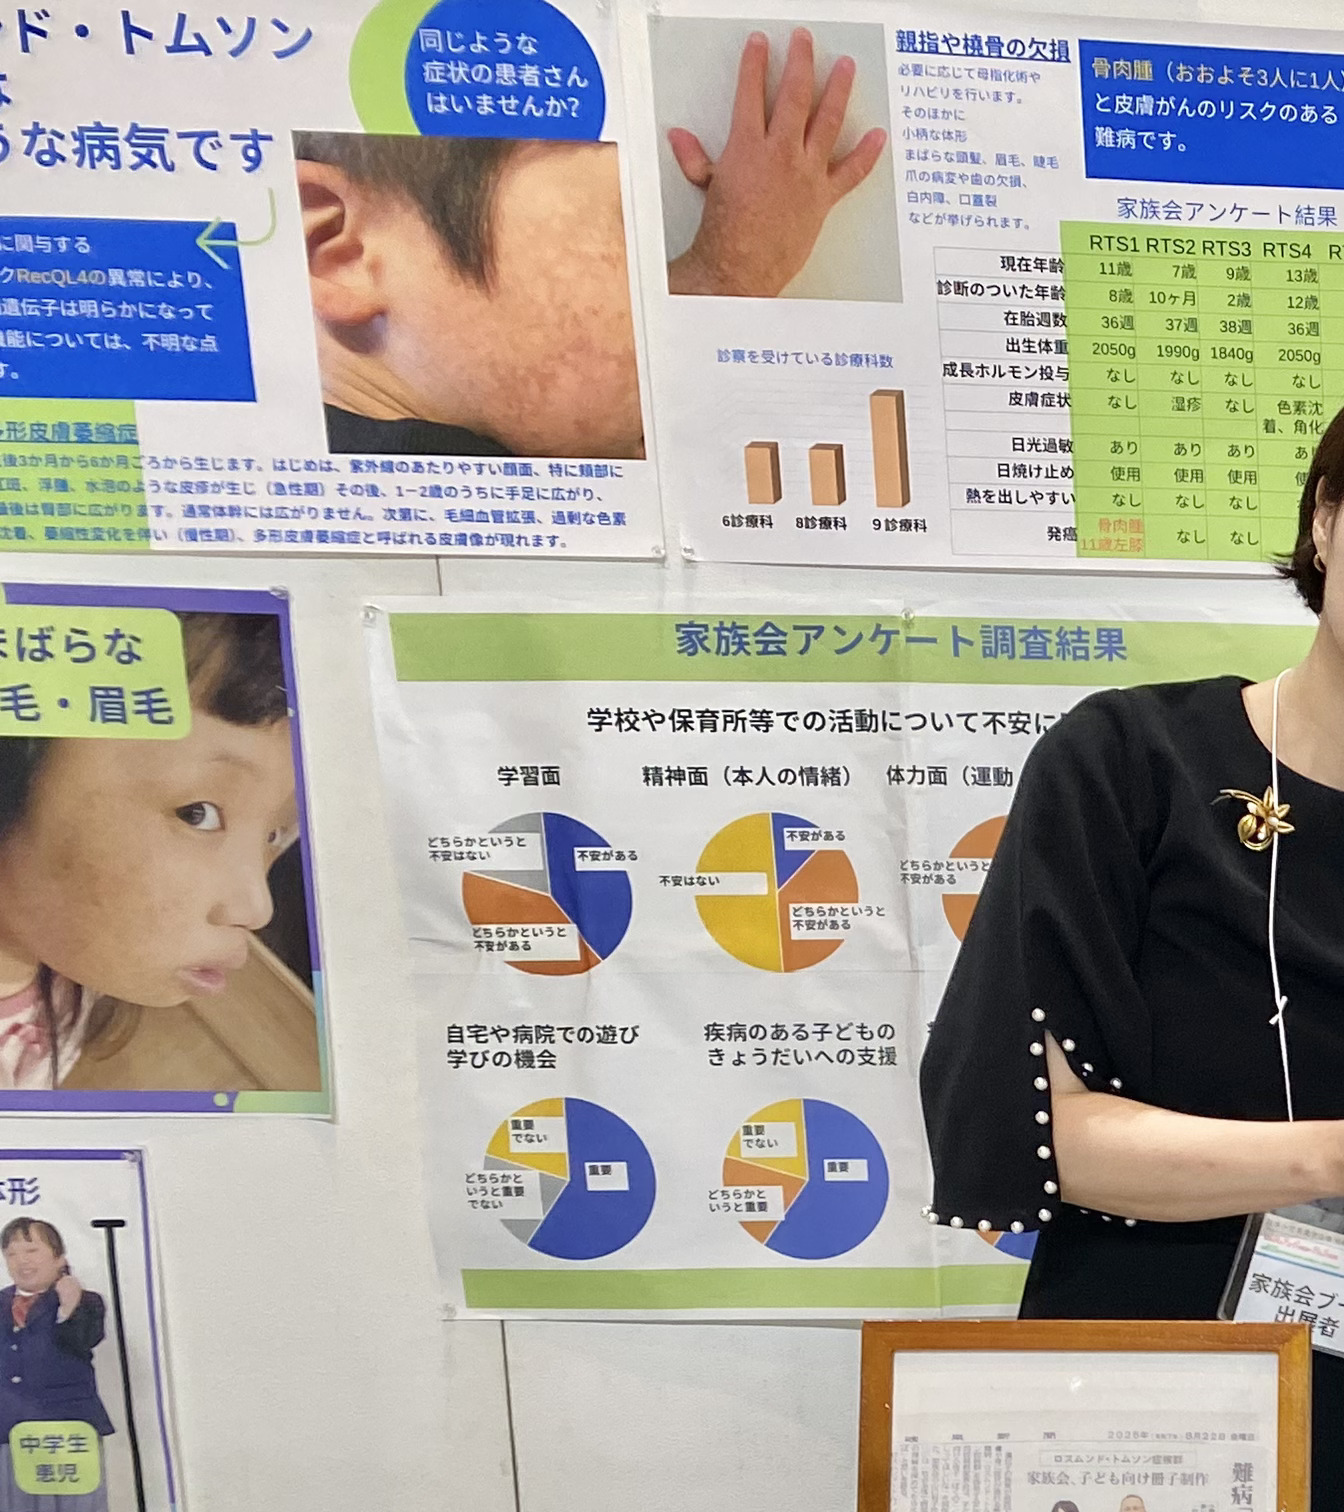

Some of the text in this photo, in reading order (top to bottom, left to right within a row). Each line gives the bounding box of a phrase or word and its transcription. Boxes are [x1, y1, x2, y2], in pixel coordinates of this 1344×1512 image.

[0, 9, 314, 58] ド・トムソン
[418, 28, 538, 55] 同じような
[422, 63, 589, 89] 症状の患者さん
[900, 85, 1023, 104] リハビリを行います。
[902, 106, 966, 121] そのほかに
[1094, 92, 1339, 126] と皮膚がんのリスクのある
[903, 128, 968, 143] 小柄な体形
[1094, 126, 1190, 154] 難病です。
[909, 212, 1030, 230] などが挙げられます。
[1116, 197, 1339, 228] 家族会アンケート結果
[1089, 234, 1140, 253] RTS1
[1146, 238, 1197, 256] RTS2
[1202, 240, 1252, 258] RTS3
[1262, 242, 1312, 260] RTS4
[1000, 255, 1133, 278] 現在年齢 11歳
[936, 280, 1066, 302] 診断のついた年齢
[1004, 310, 1136, 332] 在胎週数 36週
[1005, 337, 1322, 365] 出生体重 1840g 2050g
[942, 362, 1070, 383] 成長ホルモン投与
[1008, 390, 1072, 410] 皮膚症状
[1011, 436, 1075, 455] 日光過敏
[996, 463, 1075, 481] 日焼け止め
[965, 488, 1077, 506] 熱を出しやすい
[722, 513, 774, 531] 6診療科
[795, 514, 848, 533] 8診療科
[675, 621, 1128, 662] 家族会アンケート調査結果
[497, 764, 1014, 788] 学習面 精神面（本人の情緒） 体力面（運動
[428, 836, 526, 849] どちらかというと
[785, 829, 846, 843] 不安がある
[429, 849, 639, 862] 不安はない 不安がある
[659, 874, 721, 887] 不安はない
[792, 905, 886, 919] どちらかというと
[792, 918, 852, 931] 不安がある
[446, 1022, 896, 1047] 自宅や病院での遊び 疾病のある子どもの
[446, 1045, 898, 1070] 学びの機会 きょうだいへの支援
[588, 1161, 850, 1177] 重要 重要
[465, 1173, 524, 1186] どちらかと
[466, 1186, 526, 1198] いうと重要
[20, 1434, 90, 1455] 中学生
